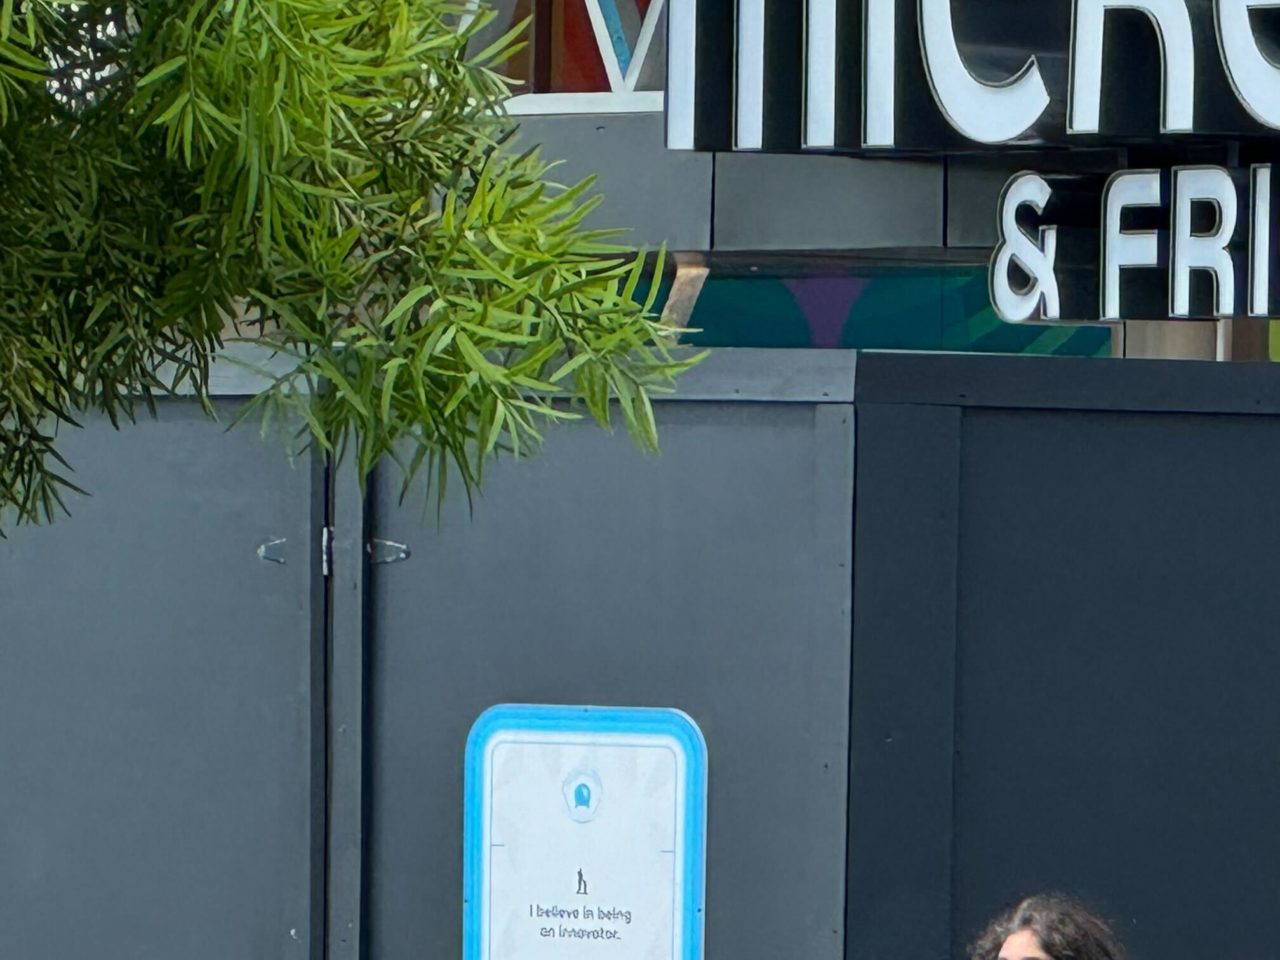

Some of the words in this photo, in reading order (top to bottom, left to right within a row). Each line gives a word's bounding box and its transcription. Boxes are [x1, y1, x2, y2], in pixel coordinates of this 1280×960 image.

[990, 171, 1061, 322] &
[536, 904, 579, 918] believe
[583, 906, 594, 919] in
[598, 907, 632, 924] being
